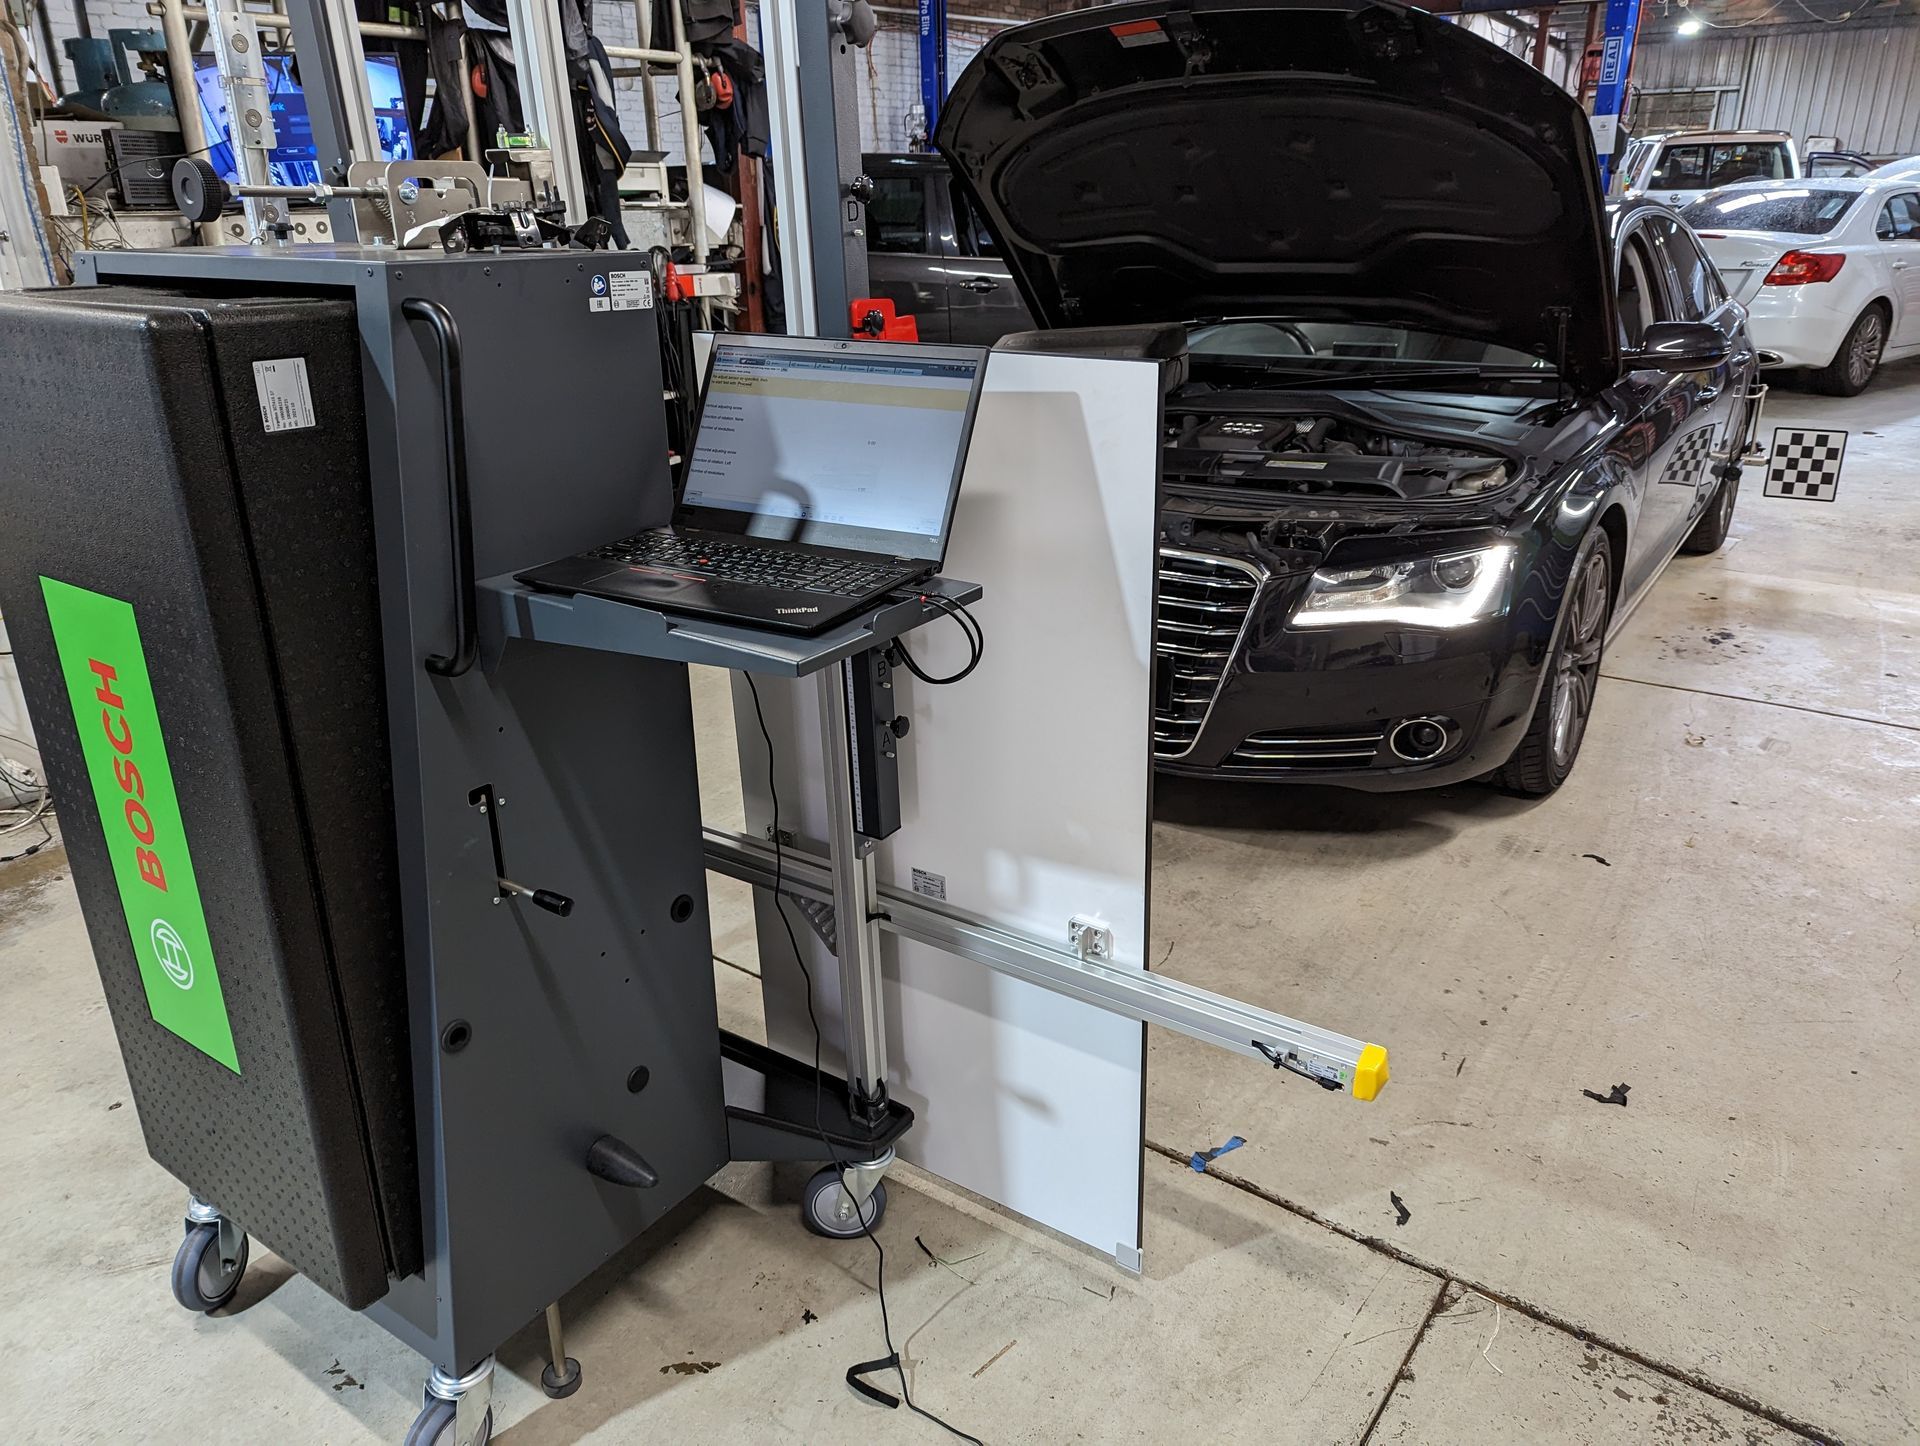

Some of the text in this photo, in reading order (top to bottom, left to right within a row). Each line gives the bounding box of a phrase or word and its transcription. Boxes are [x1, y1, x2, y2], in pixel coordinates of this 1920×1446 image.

[921, 0, 930, 36] Pro Elite
[1605, 42, 1619, 78] REAL
[73, 134, 102, 143] WÜR
[847, 200, 859, 222] D
[775, 606, 819, 615] ThinkPad
[877, 661, 888, 677] B
[882, 731, 892, 749] A
[89, 657, 168, 894] BOSCH
